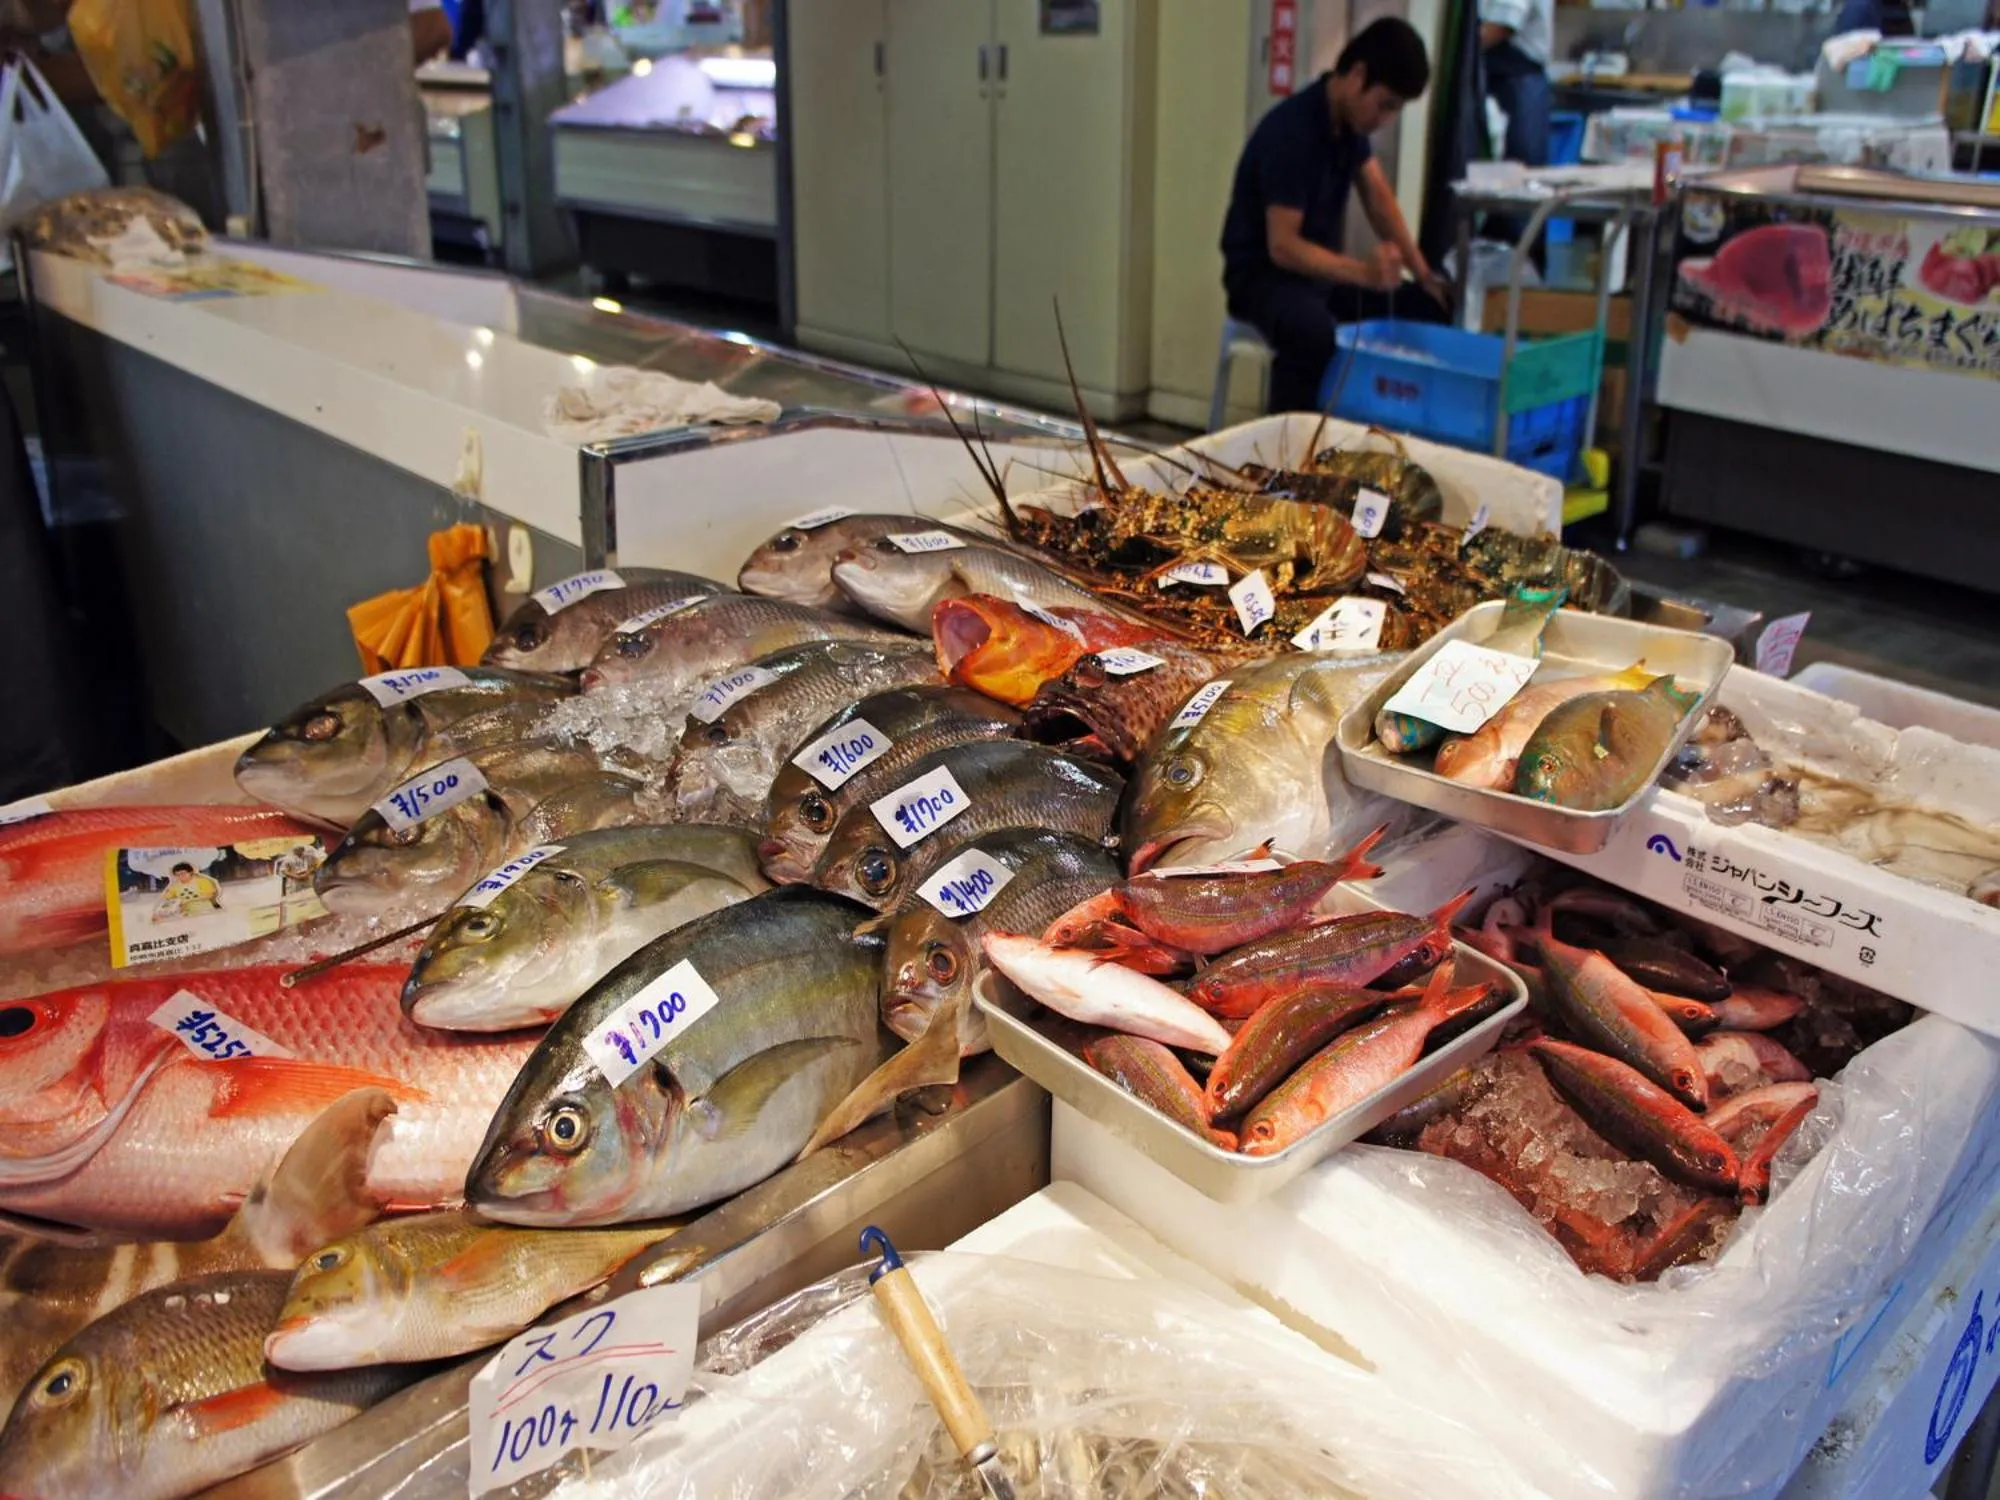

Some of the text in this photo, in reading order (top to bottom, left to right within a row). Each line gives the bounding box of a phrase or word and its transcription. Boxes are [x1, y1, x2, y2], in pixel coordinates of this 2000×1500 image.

[819, 734, 874, 774] ¥1600
[389, 774, 458, 818] ¥1500
[1710, 855, 1883, 938] ジャパンシーフーズ
[176, 1010, 252, 1059] ¥525
[605, 992, 686, 1064] ¥1700
